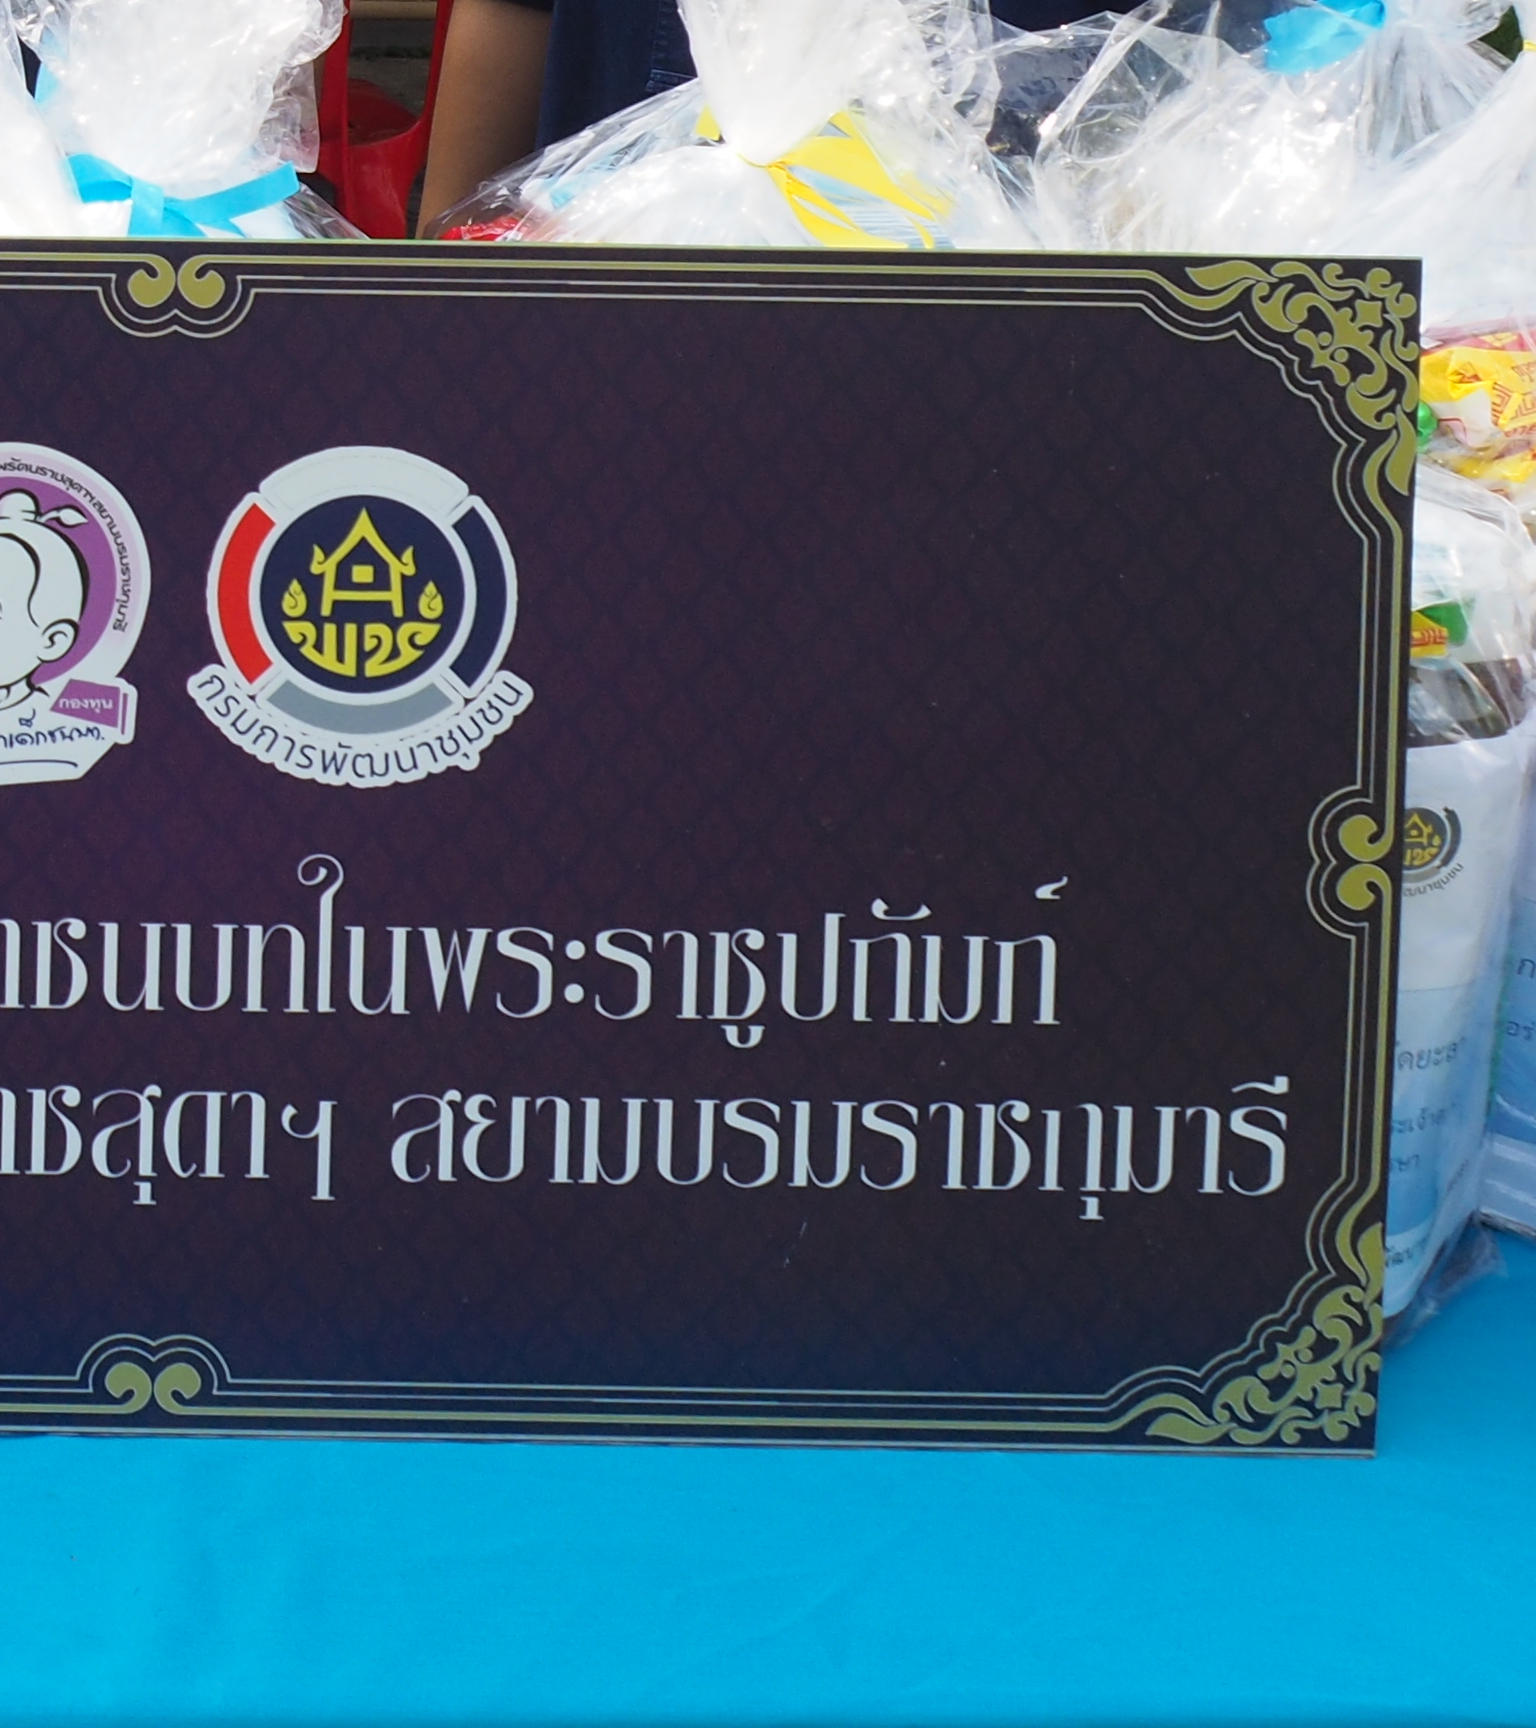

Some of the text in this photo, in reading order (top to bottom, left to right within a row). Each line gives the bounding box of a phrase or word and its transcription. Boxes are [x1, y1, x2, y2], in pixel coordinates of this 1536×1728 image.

[58, 696, 114, 714] กองทุน
[195, 671, 525, 778] กรมการพัฒนาชุมชน
[391, 1075, 1290, 1220] สยามบรมราชกุมารี
